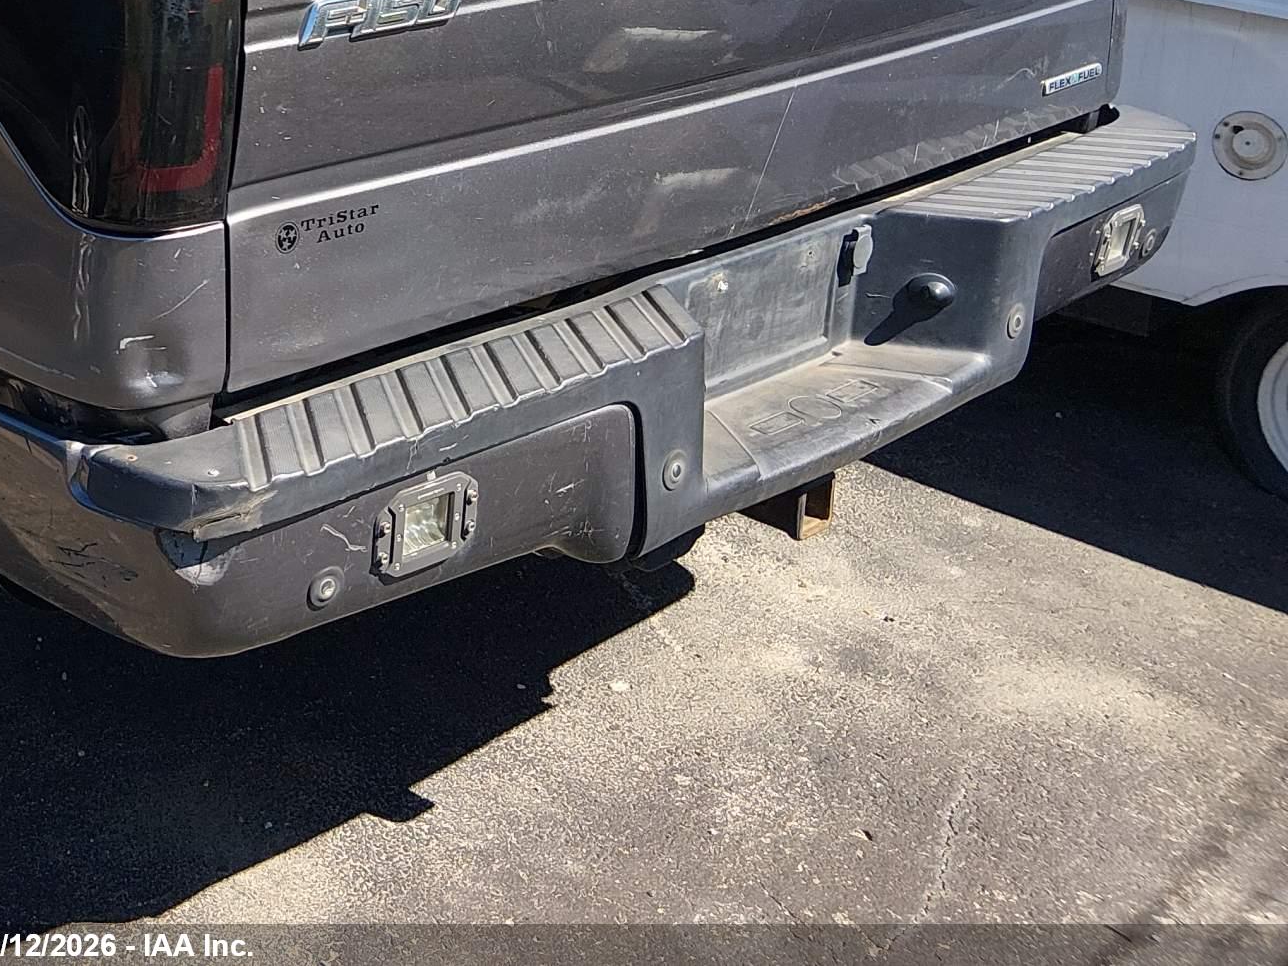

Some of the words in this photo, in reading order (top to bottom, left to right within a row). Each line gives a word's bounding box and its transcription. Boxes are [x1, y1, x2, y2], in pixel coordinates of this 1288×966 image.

[1048, 76, 1072, 92] FLEX
[1078, 66, 1099, 82] FUEL
[300, 204, 379, 232] TriStar
[316, 222, 365, 244] Auto
